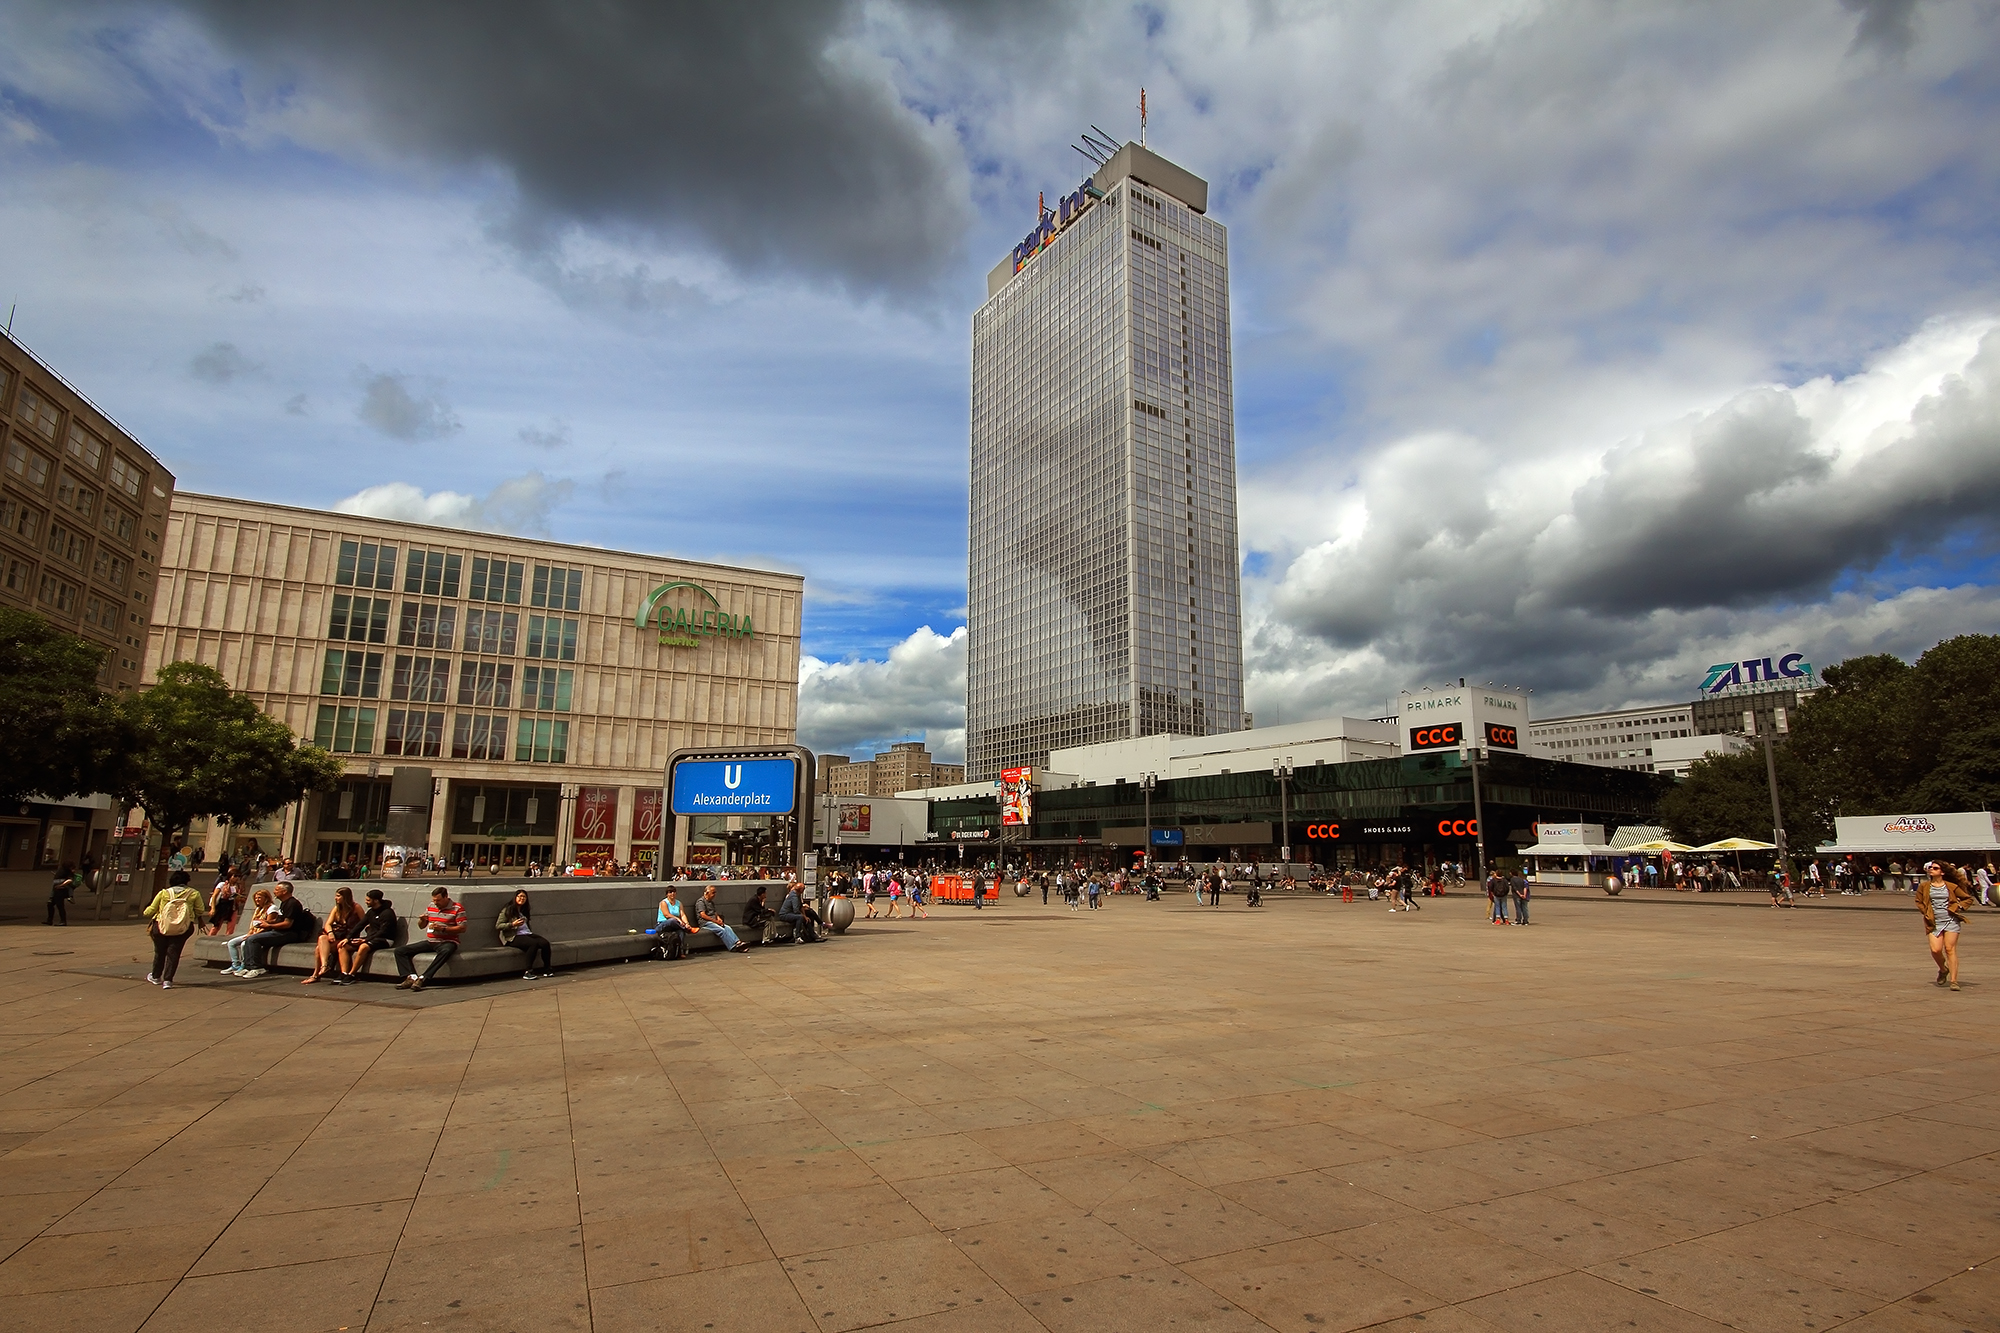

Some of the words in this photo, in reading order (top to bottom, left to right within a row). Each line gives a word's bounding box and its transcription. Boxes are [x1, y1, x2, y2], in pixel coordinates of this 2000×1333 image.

[1012, 211, 1057, 276] park
[657, 605, 754, 640] GALERIA
[1407, 696, 1462, 712] PRIMARK
[1484, 696, 1517, 711] PRIMARK
[1416, 727, 1455, 745] CCC
[1491, 727, 1515, 745] CCC
[724, 764, 741, 789] U
[693, 792, 771, 808] Alexanderplatz
[1164, 830, 1170, 839] U
[1307, 824, 1340, 839] CCC
[1438, 819, 1478, 836] CCC
